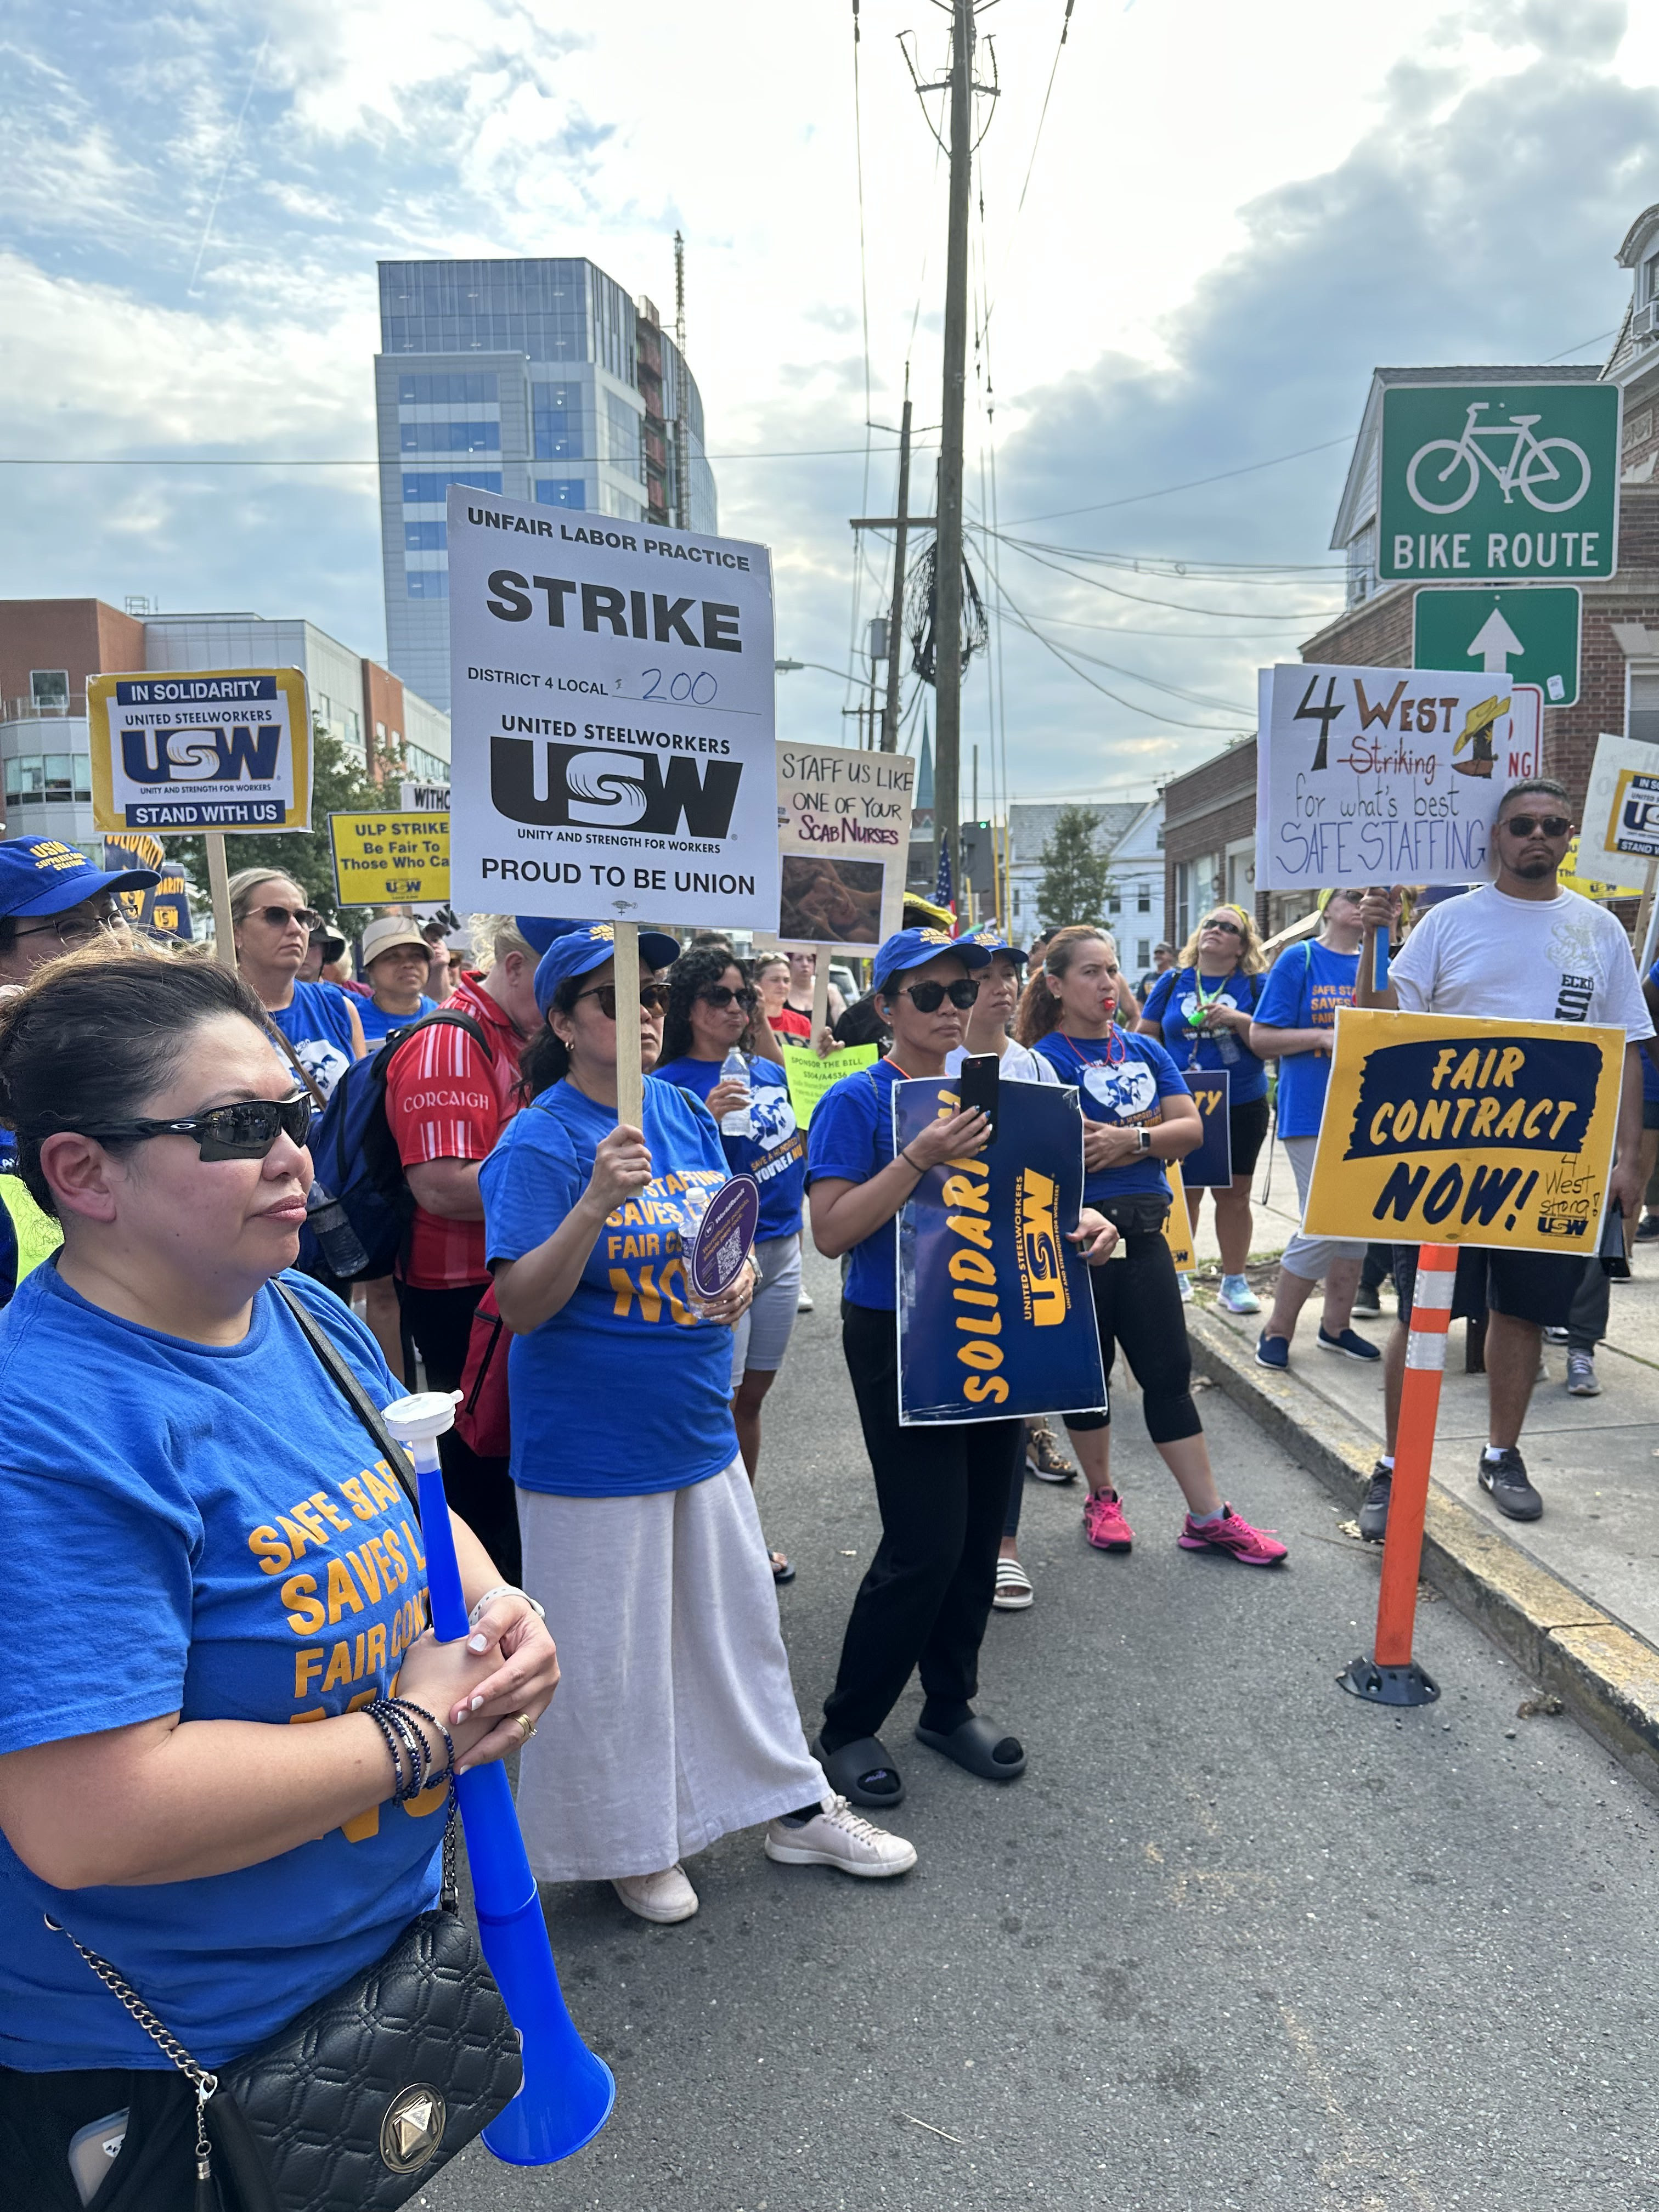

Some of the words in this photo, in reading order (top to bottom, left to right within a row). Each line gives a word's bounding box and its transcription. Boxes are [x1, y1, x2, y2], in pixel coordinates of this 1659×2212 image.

[468, 507, 553, 538] UNFAIR
[561, 524, 636, 551] LABOR
[644, 539, 751, 572] PRACTICE
[1393, 534, 1471, 569] BIKE
[1487, 532, 1599, 568] ROUTE
[487, 569, 742, 653] STRIKE
[131, 684, 149, 701] IN
[154, 680, 261, 699] SOLIDARITY
[468, 667, 540, 687] DISTRICT
[545, 677, 554, 689] 4
[557, 678, 608, 696] LOCAL
[642, 668, 718, 705] 200
[126, 713, 171, 725] UNITED
[176, 710, 272, 724] STEELWORKERS
[501, 715, 576, 737] UNITED
[584, 724, 730, 754] STEELWORKERS
[1293, 675, 1345, 771] 4
[1353, 679, 1459, 733] WEST
[120, 725, 281, 783] USW
[782, 753, 843, 783] STAFF
[848, 762, 870, 783] US
[877, 767, 913, 791] LIKE
[182, 785, 217, 793] STRENGTH
[236, 784, 271, 792] WORKERS
[490, 736, 743, 839] USW
[1340, 775, 1397, 817] what's
[1414, 775, 1460, 816] best
[136, 806, 198, 823] STAND
[200, 805, 248, 822] WITH
[253, 804, 278, 821] US
[793, 792, 830, 812] ONE
[835, 797, 856, 814] OF
[861, 797, 902, 821] YOUR
[356, 825, 386, 836] ULP
[392, 822, 449, 836] STRIKE
[517, 828, 554, 840] UNITY
[556, 832, 583, 843] AND
[585, 833, 642, 847] STRENGTH
[645, 838, 665, 850] FOR
[668, 840, 721, 854] WORKERS
[1276, 821, 1352, 874] SAFE
[1358, 819, 1486, 872] STAFFING
[1621, 840, 1652, 854] STAND
[30, 841, 71, 858] USW
[341, 858, 387, 871] Those
[393, 857, 425, 868] Who
[430, 856, 450, 867] Ca
[364, 843, 383, 854] Be
[389, 842, 417, 853] Fair
[422, 841, 440, 853] To
[482, 858, 581, 884] PROUD
[590, 865, 625, 887] TO
[634, 869, 667, 890] BE
[675, 873, 755, 895] UNION
[791, 1057, 821, 1069] SPONSOR
[843, 1058, 863, 1066] BILL
[1432, 1046, 1525, 1091] FAIR
[403, 1090, 489, 1114] CORCAIGH
[1370, 1097, 1577, 1146] CONTRACT
[751, 1155, 768, 1172] SAVE
[1546, 1165, 1595, 1194] West
[1561, 1154, 1577, 1177] 4
[606, 1201, 682, 1227] SAVES
[1372, 1161, 1539, 1231] NOW!
[1015, 1175, 1026, 1270] STEELWORKERS
[1538, 1216, 1589, 1236] USW
[608, 1233, 659, 1260] FAIR
[1023, 1167, 1066, 1327] USW
[1055, 1234, 1065, 1269] STRENGTH
[1021, 1274, 1032, 1319] UNITED
[1063, 1287, 1071, 1309] UNITY
[249, 1492, 353, 1576] SAFE
[280, 1529, 410, 1635] SAVES
[295, 1623, 386, 1699] FAIR
